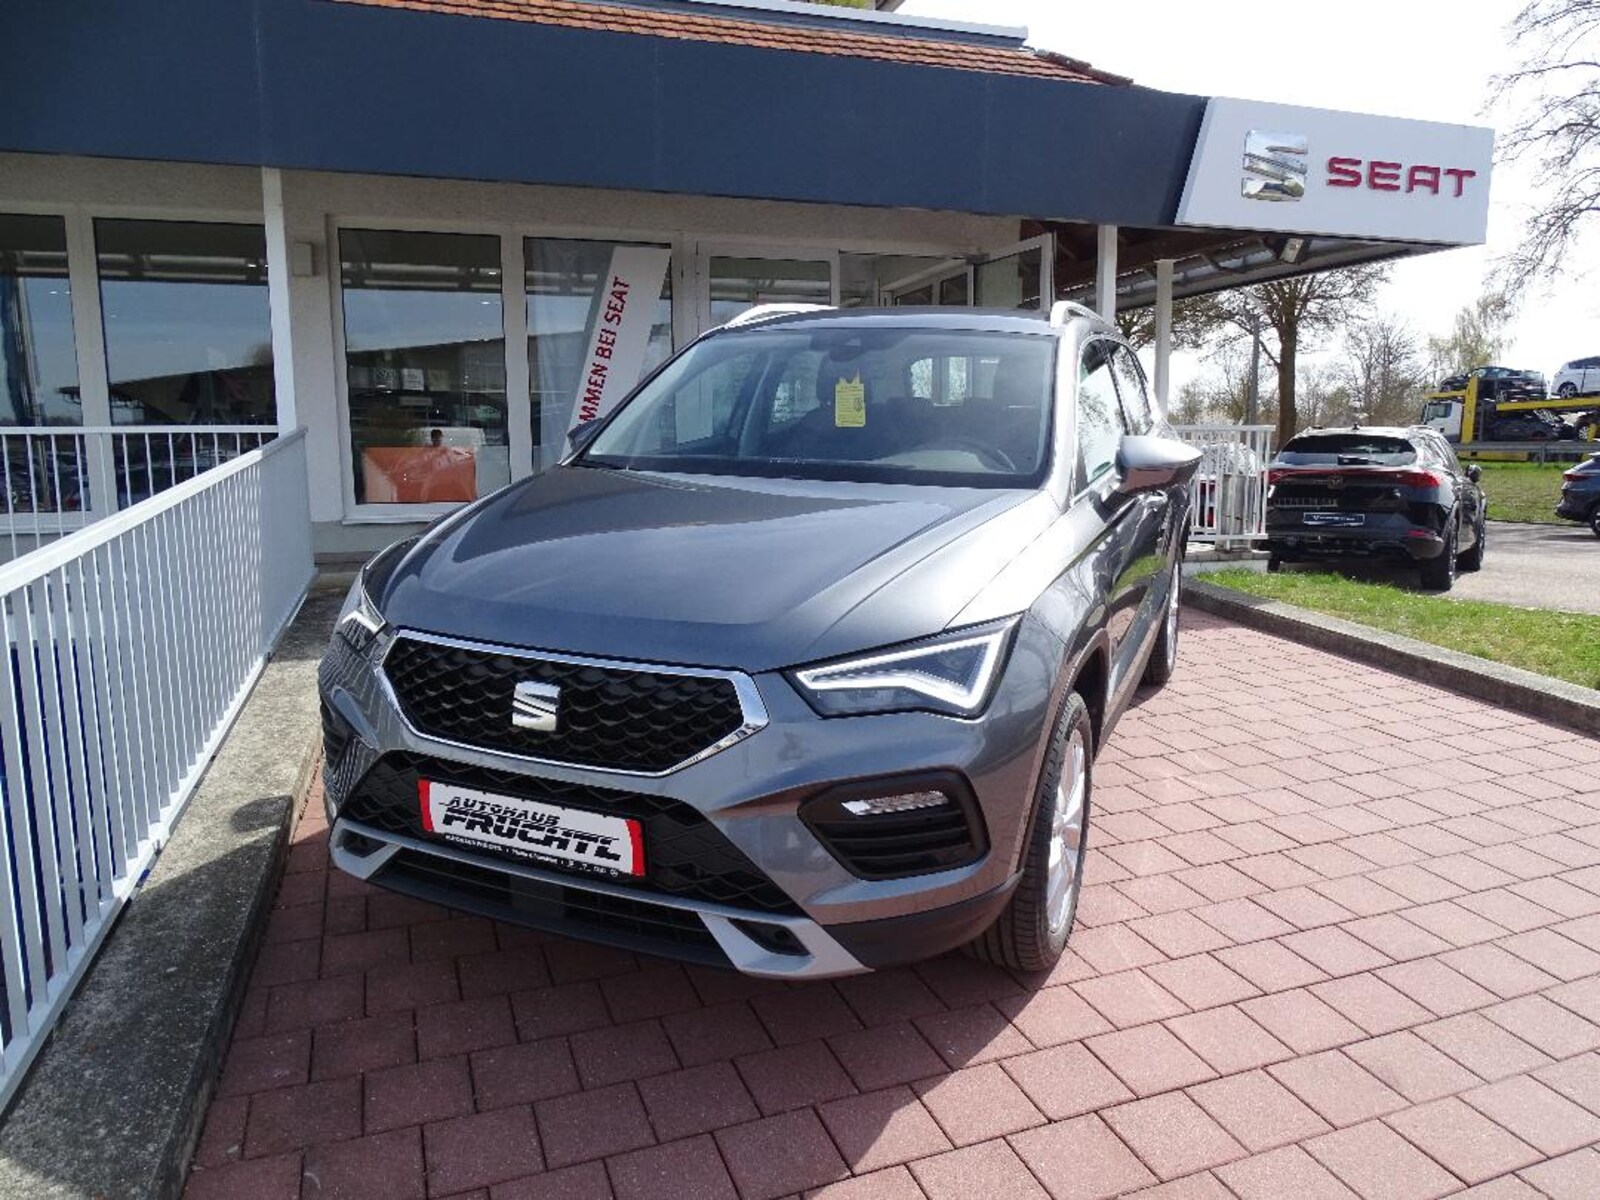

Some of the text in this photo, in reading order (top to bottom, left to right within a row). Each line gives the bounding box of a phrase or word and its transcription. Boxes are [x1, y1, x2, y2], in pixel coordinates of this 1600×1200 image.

[1326, 156, 1477, 197] SEAT
[578, 276, 631, 423] MMEN BEI SEAT
[449, 796, 560, 826] AUTOHAUS
